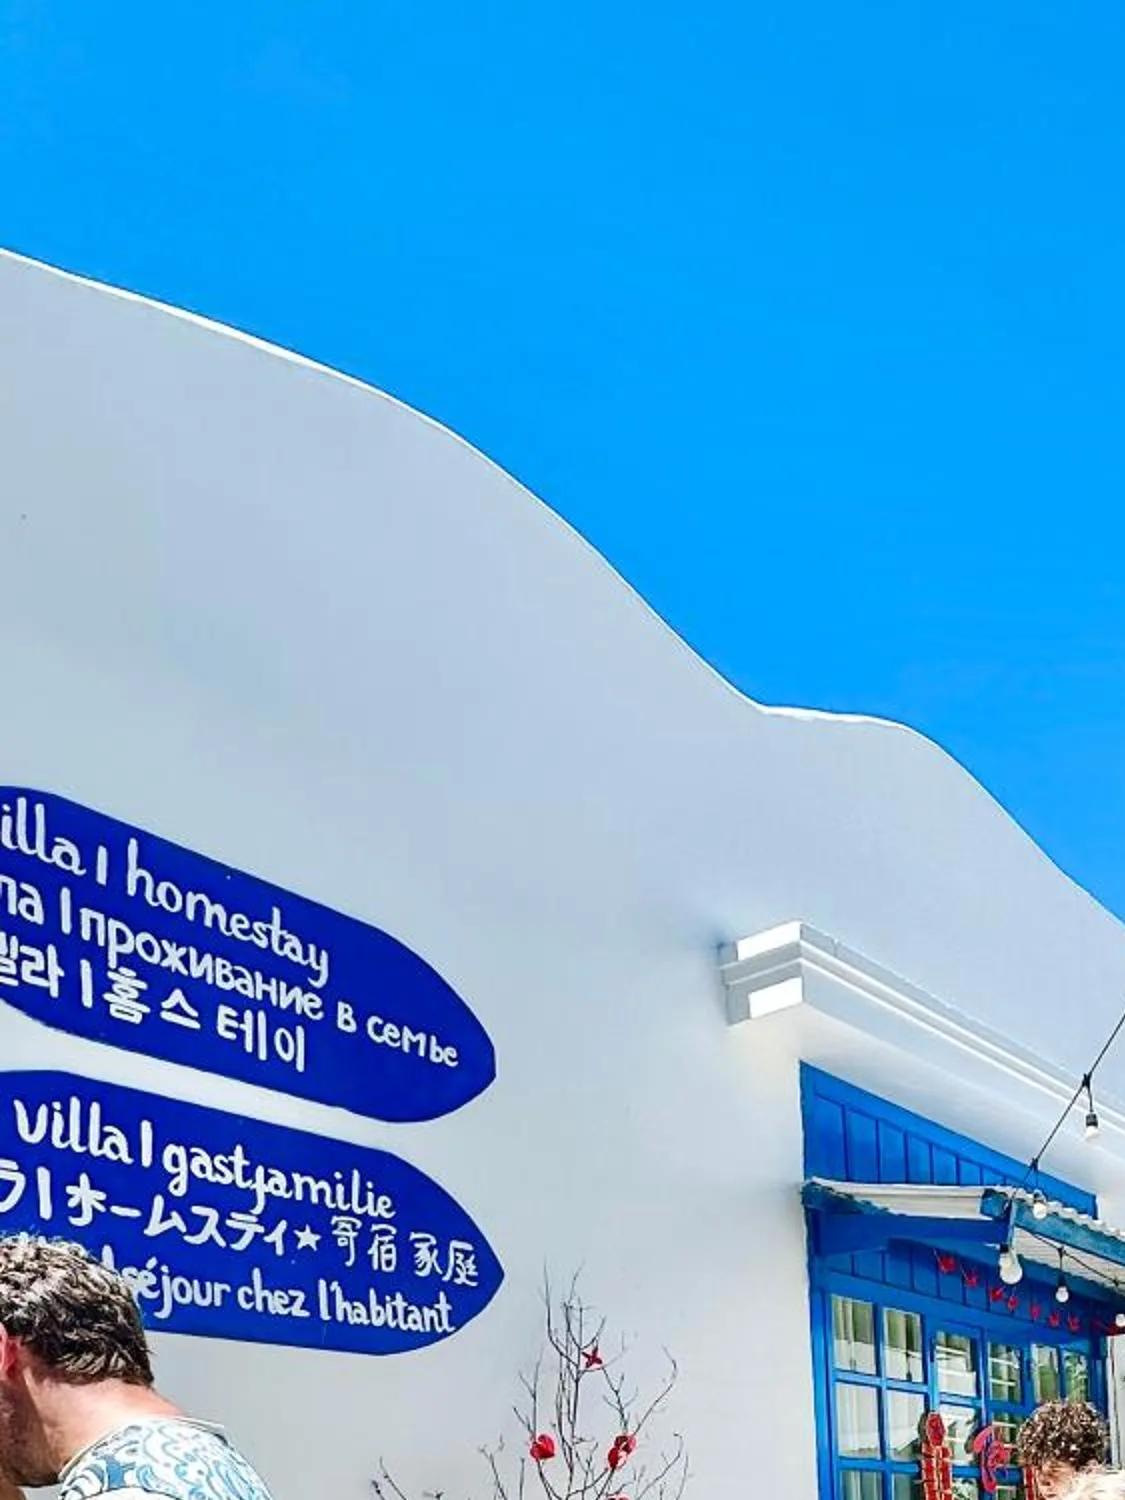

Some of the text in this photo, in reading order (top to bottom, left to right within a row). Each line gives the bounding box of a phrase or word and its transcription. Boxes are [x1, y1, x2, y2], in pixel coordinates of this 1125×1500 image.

[80, 907, 324, 1020] проживание
[127, 838, 329, 988] homestay
[237, 1267, 310, 1317] chez
